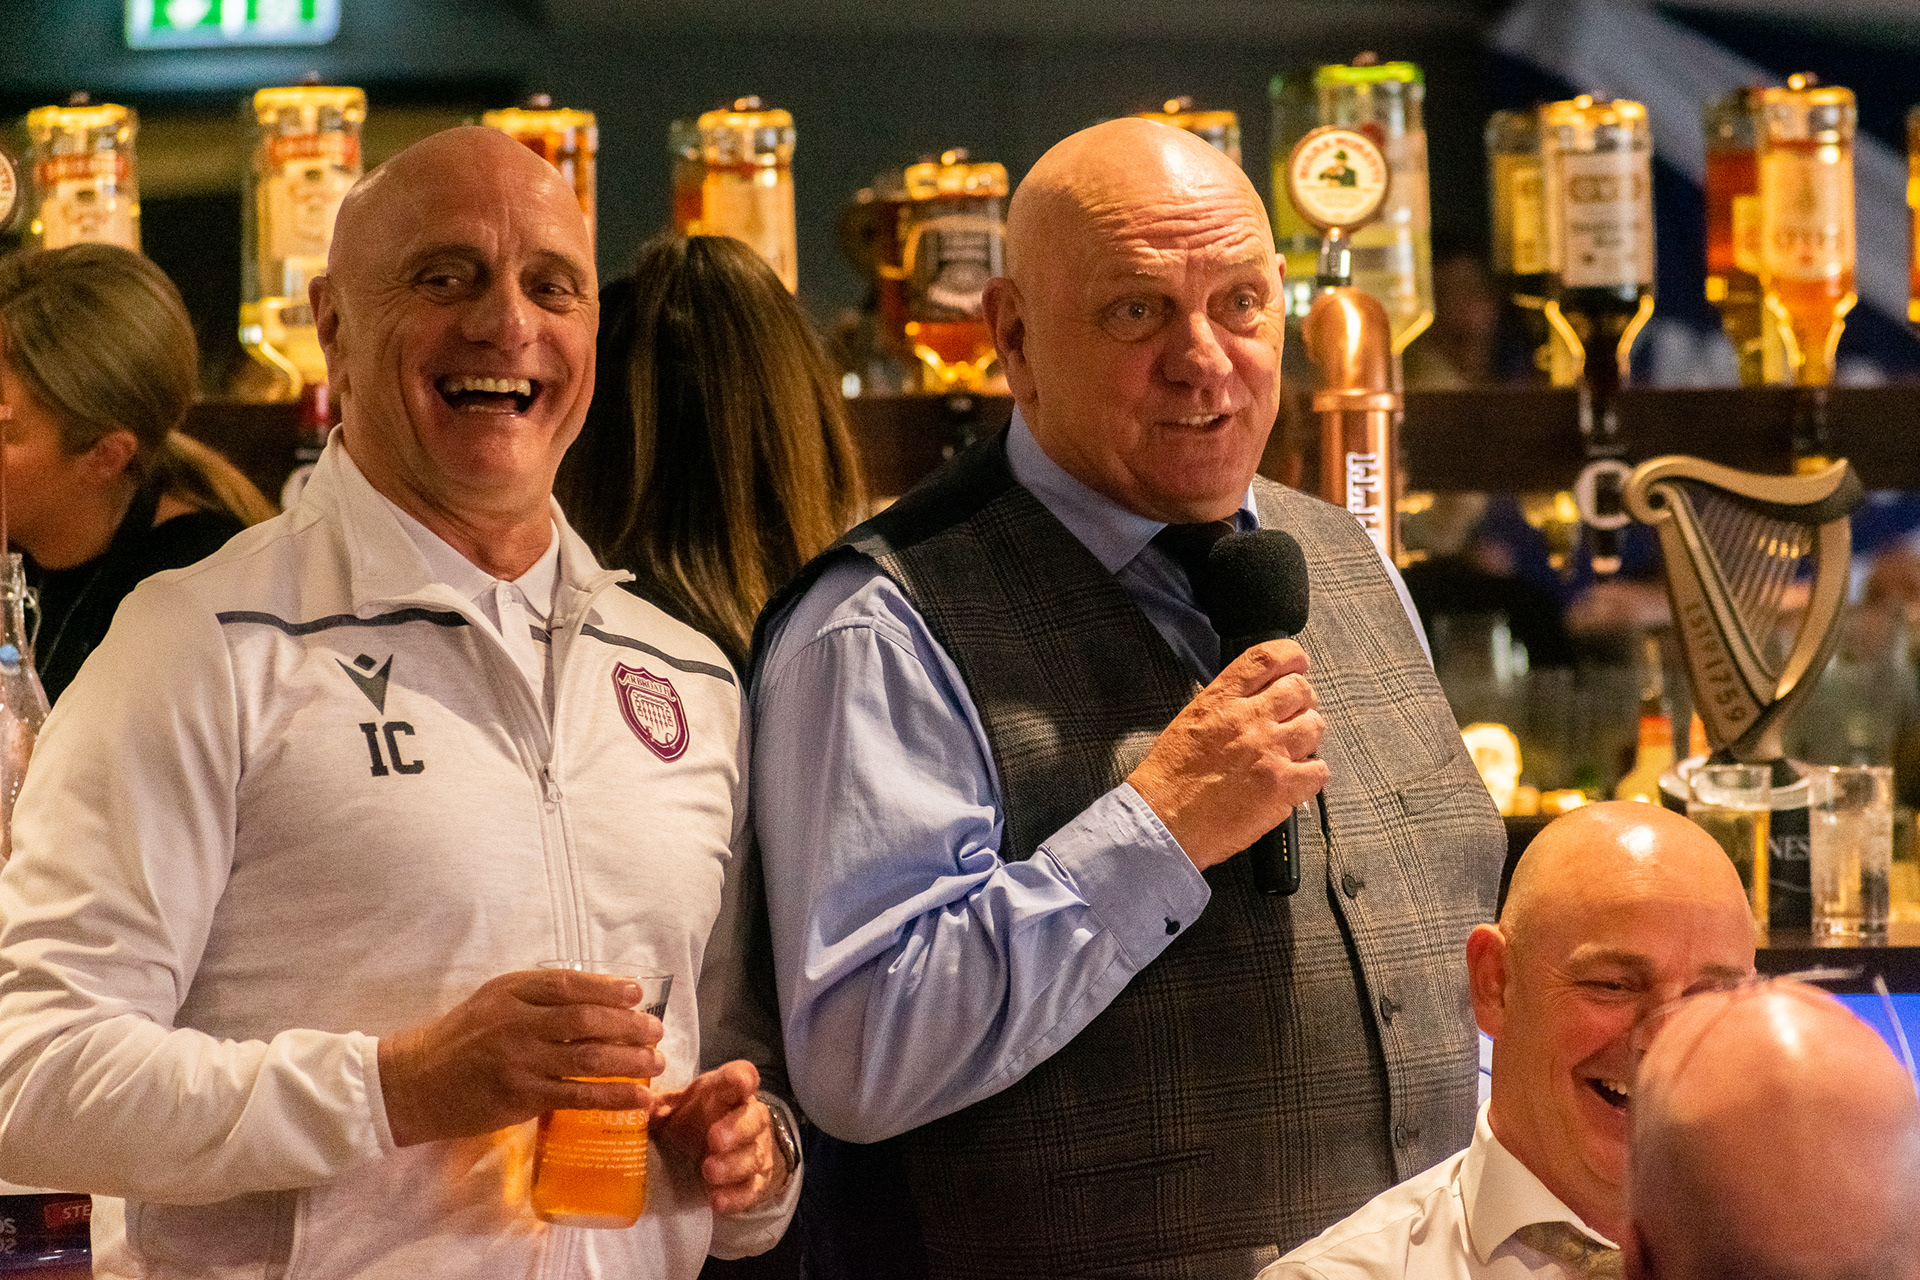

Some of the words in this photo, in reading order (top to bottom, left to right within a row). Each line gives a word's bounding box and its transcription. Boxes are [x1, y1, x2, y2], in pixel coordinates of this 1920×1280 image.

[626, 674, 671, 697] ARBROATH
[1703, 657, 1748, 723] 1759
[358, 721, 426, 777] IC
